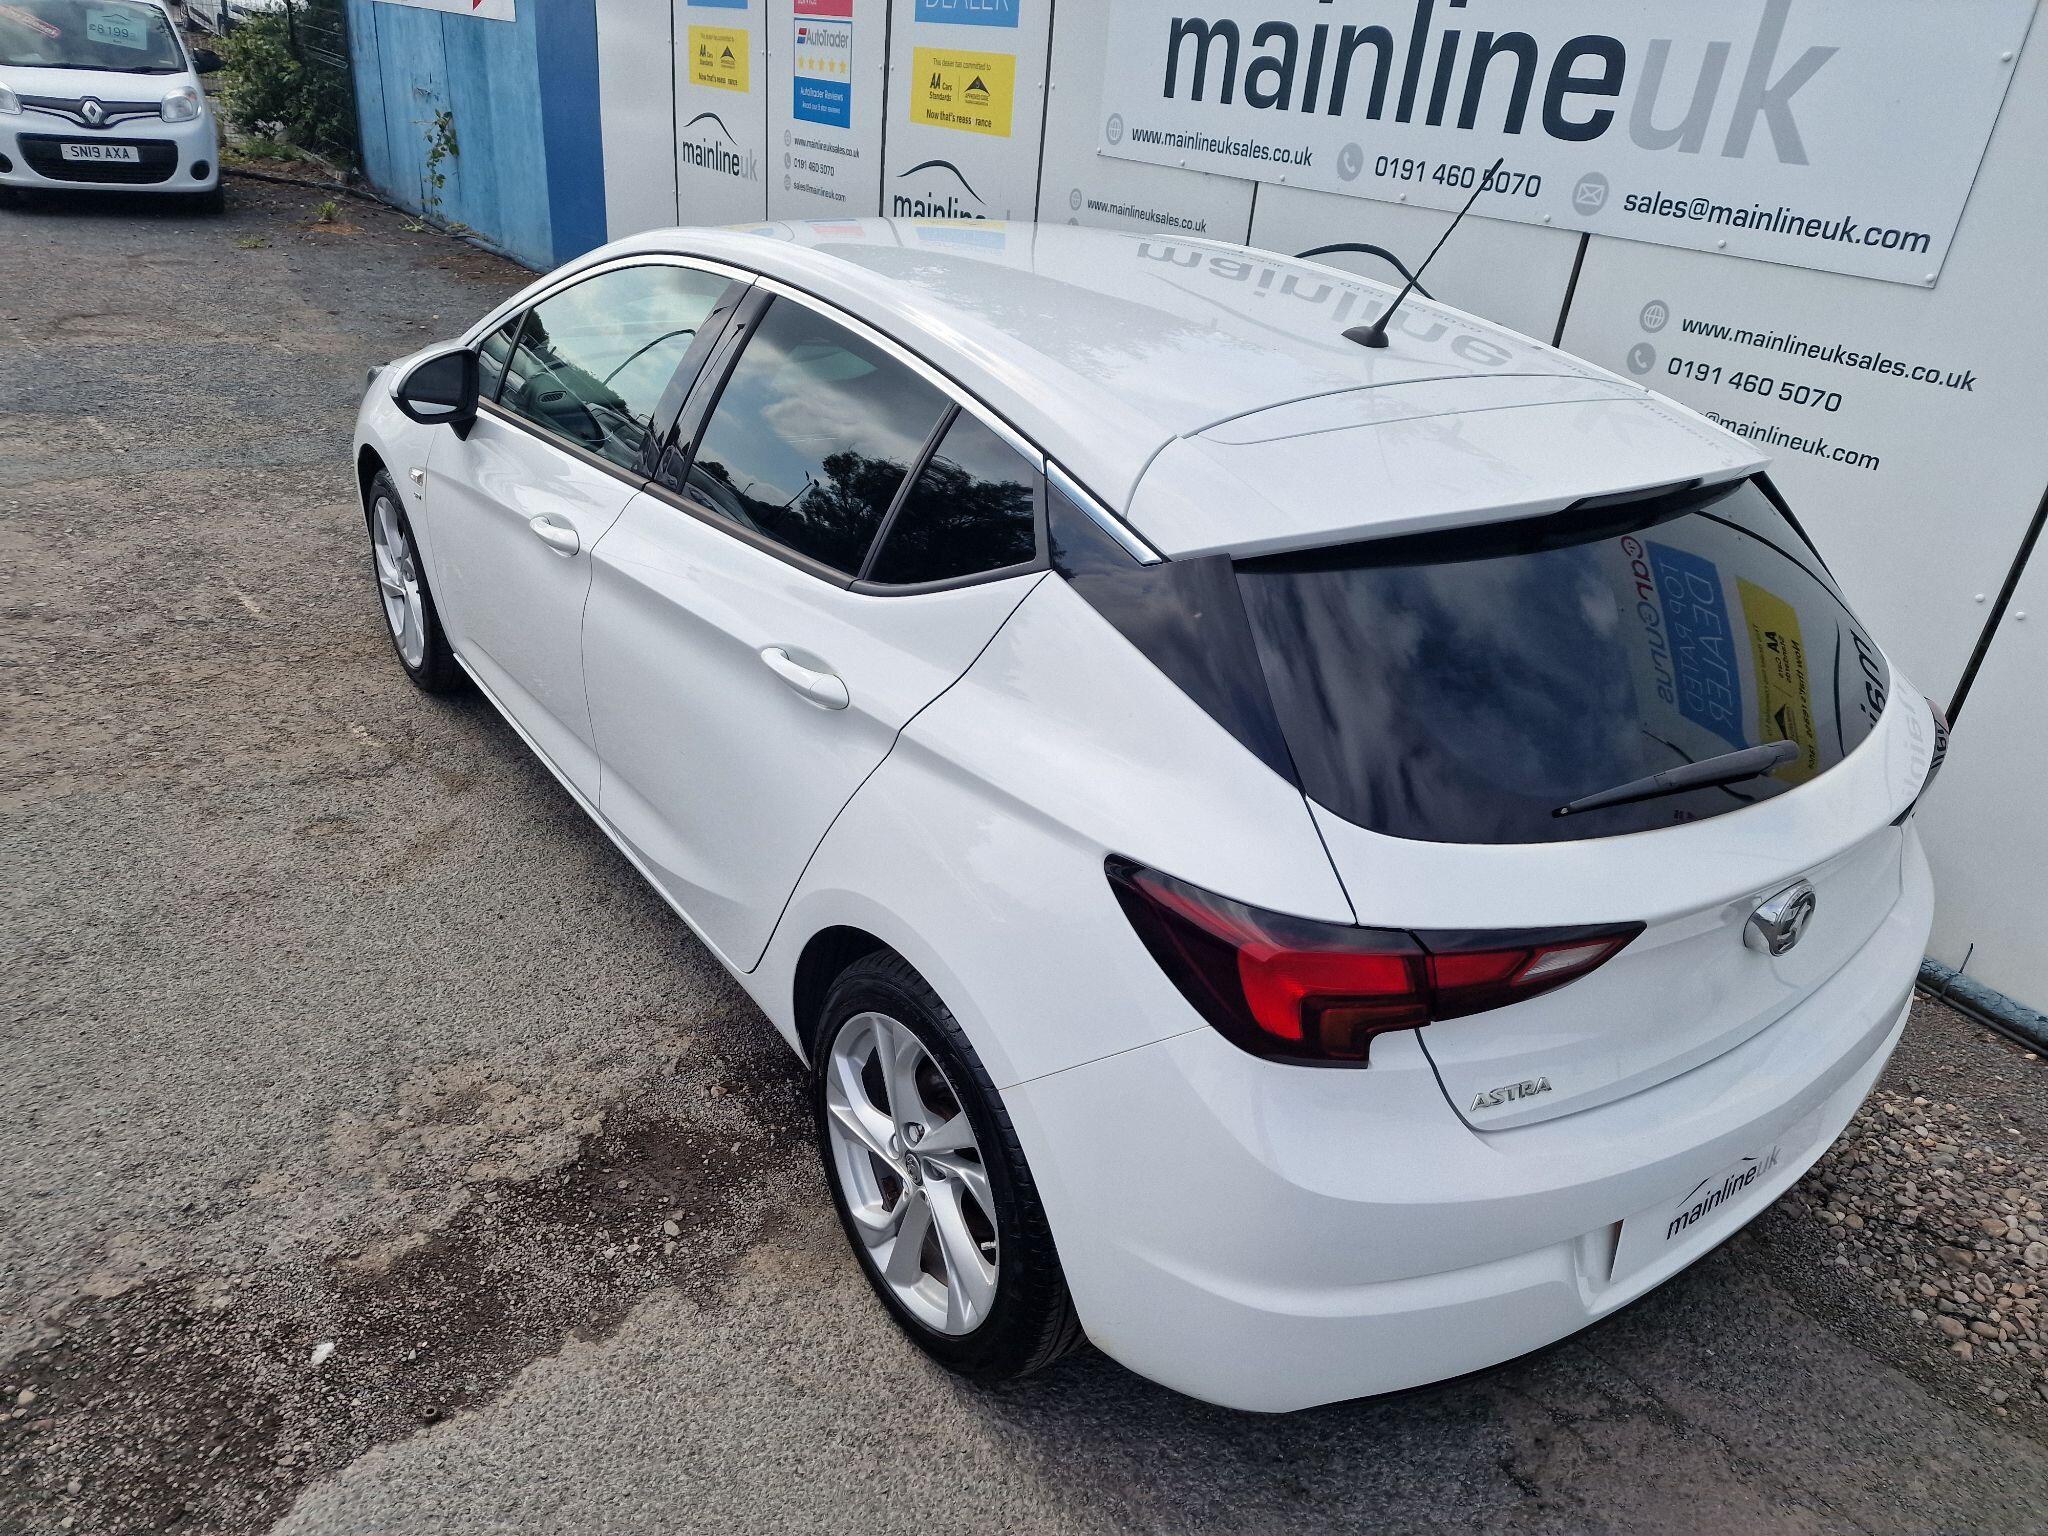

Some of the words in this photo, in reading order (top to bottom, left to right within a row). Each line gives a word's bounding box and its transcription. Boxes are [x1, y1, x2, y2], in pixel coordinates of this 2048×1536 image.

[806, 28, 849, 48] AutoTrader
[930, 72, 941, 89] AA
[1163, 0, 1840, 167] mainlineuk
[926, 108, 940, 119] Now
[940, 110, 956, 122] that's
[105, 146, 130, 159] AXA
[682, 138, 758, 181] mainlineuk
[1131, 127, 1312, 167] www.mainlineuksales.co.uk
[1374, 155, 1425, 183] 0191
[1432, 163, 1476, 189] 460
[1482, 168, 1542, 198] 5070
[1087, 199, 1207, 233] www.mainlineuksales.co.uk
[1623, 190, 1931, 253] sales@mainlineuk.com
[1682, 317, 1978, 392] www.mainlineuksales.co.uk
[1667, 357, 1723, 385] 0191
[1728, 373, 1775, 398] 460
[1778, 381, 1843, 413] 5070
[1469, 1076, 1553, 1112] ASTRA
[1666, 1145, 1783, 1241] mainlineuk
